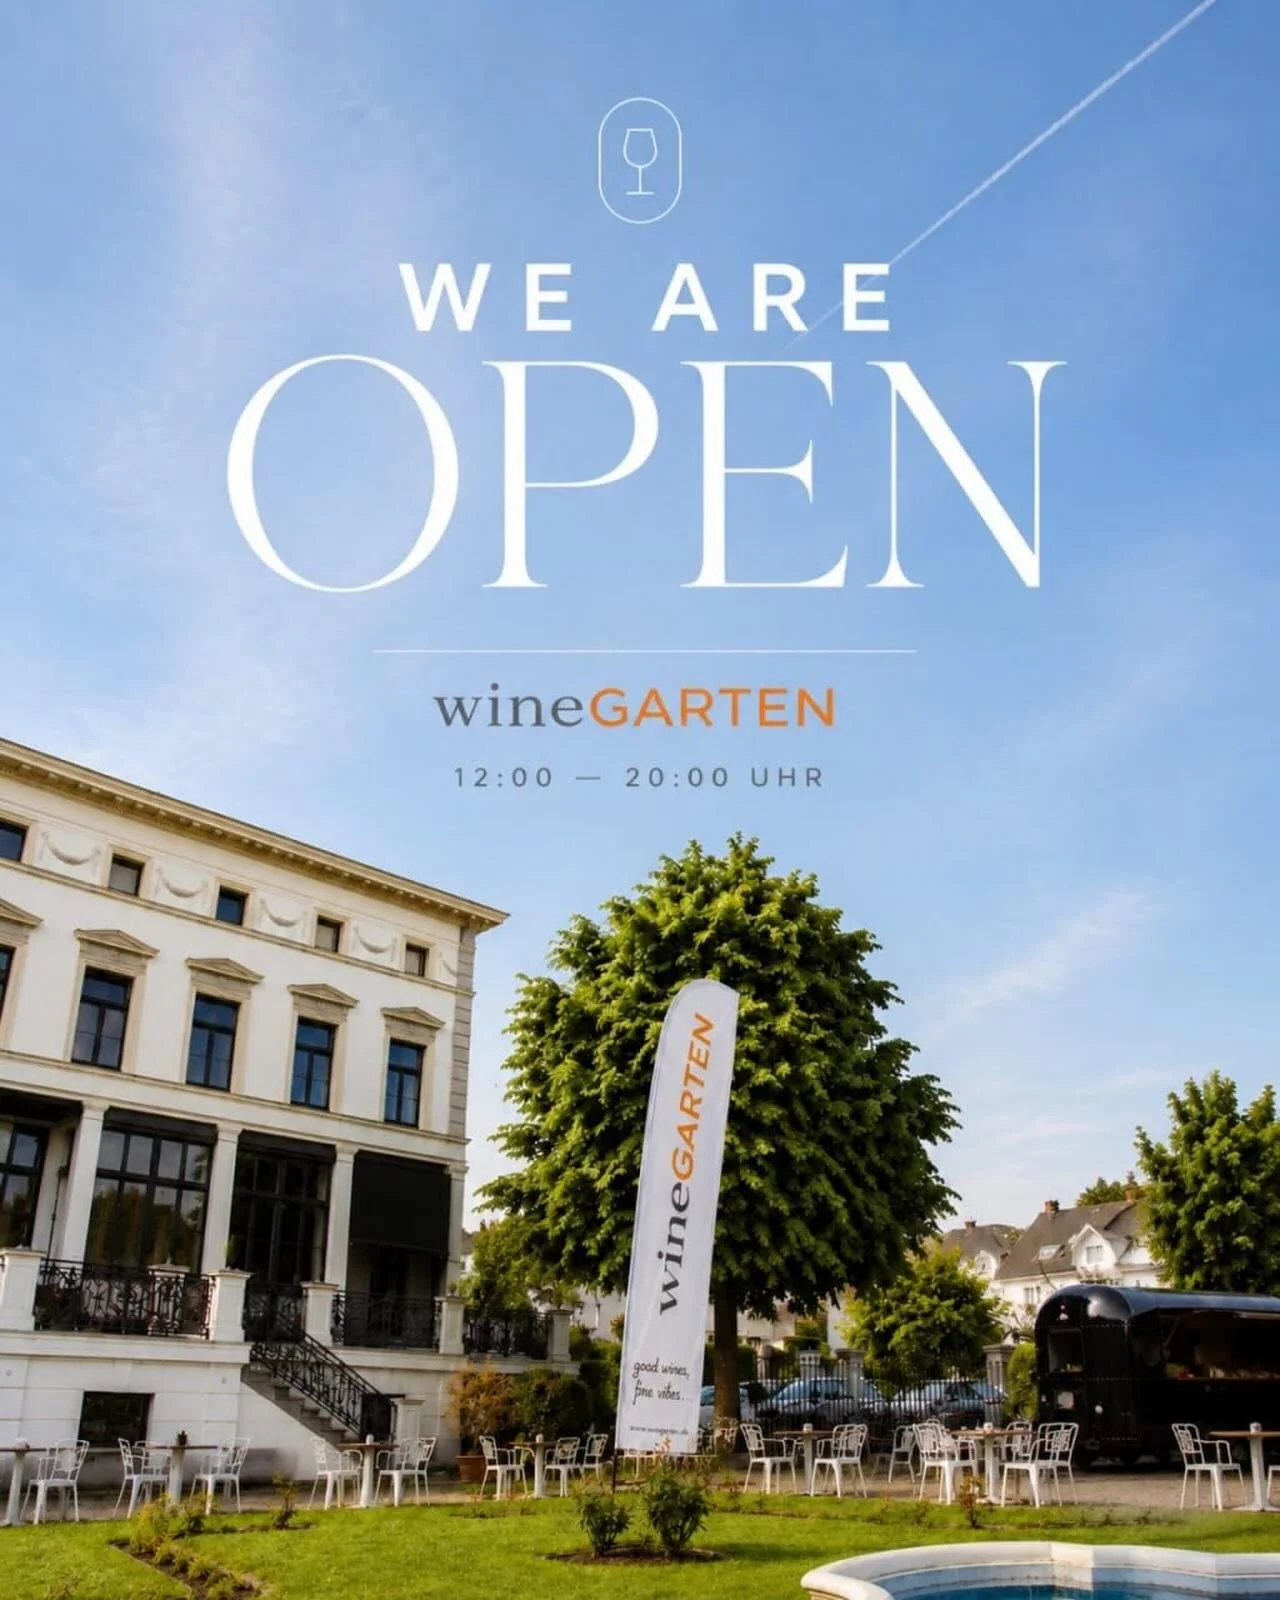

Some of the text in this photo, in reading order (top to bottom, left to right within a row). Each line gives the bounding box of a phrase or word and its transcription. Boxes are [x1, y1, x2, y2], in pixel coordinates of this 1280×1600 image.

[658, 1012, 716, 1315] wineGARTEN
[632, 1356, 659, 1379] good
[632, 1379, 654, 1406] fine
